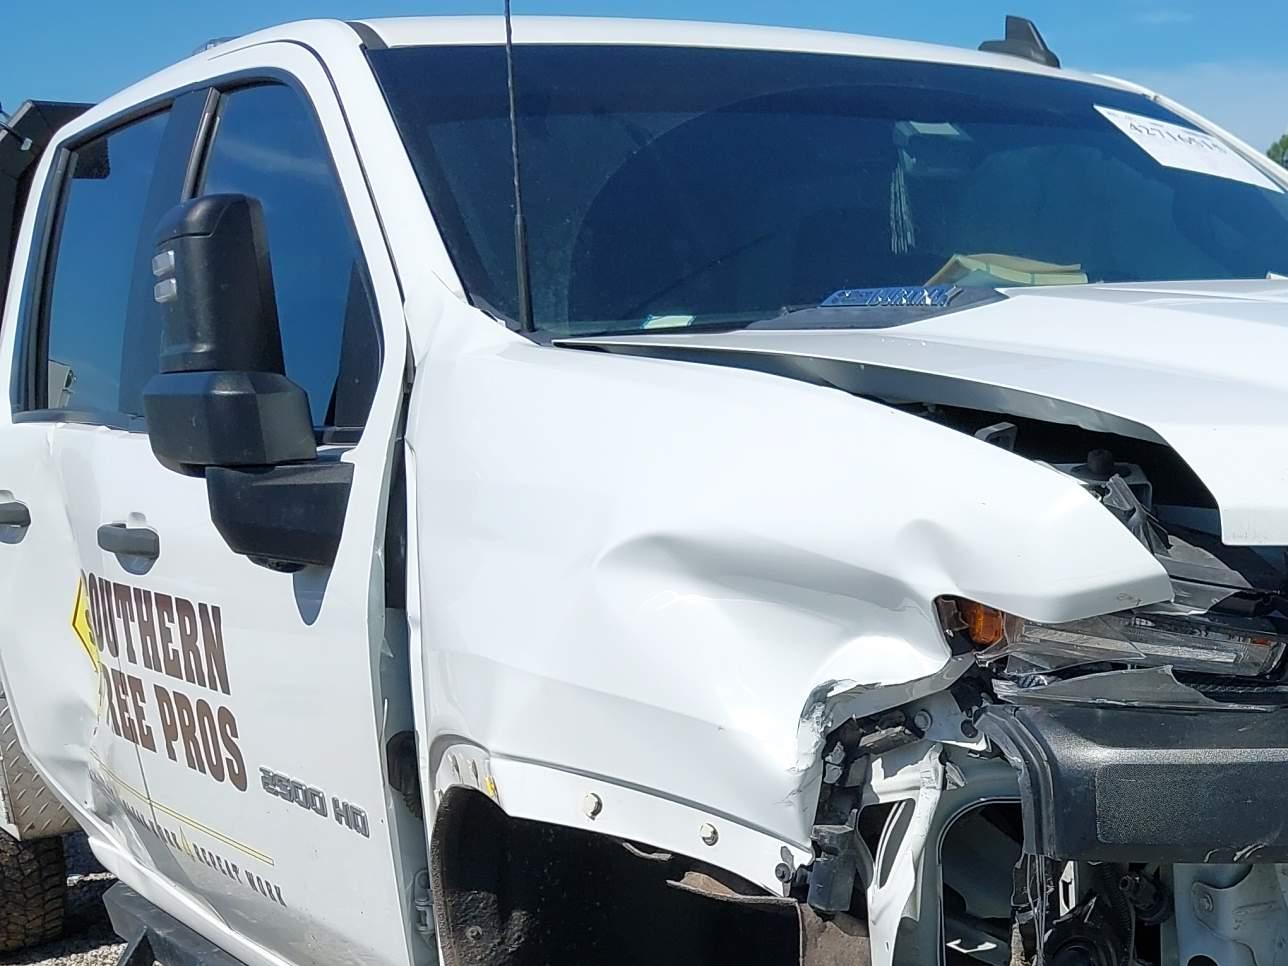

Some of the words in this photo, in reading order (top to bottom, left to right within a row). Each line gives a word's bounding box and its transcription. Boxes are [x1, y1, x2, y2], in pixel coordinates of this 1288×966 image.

[97, 660, 157, 753] REE
[153, 684, 248, 792] PROS
[259, 766, 328, 818] 2500
[331, 796, 370, 839] HD
